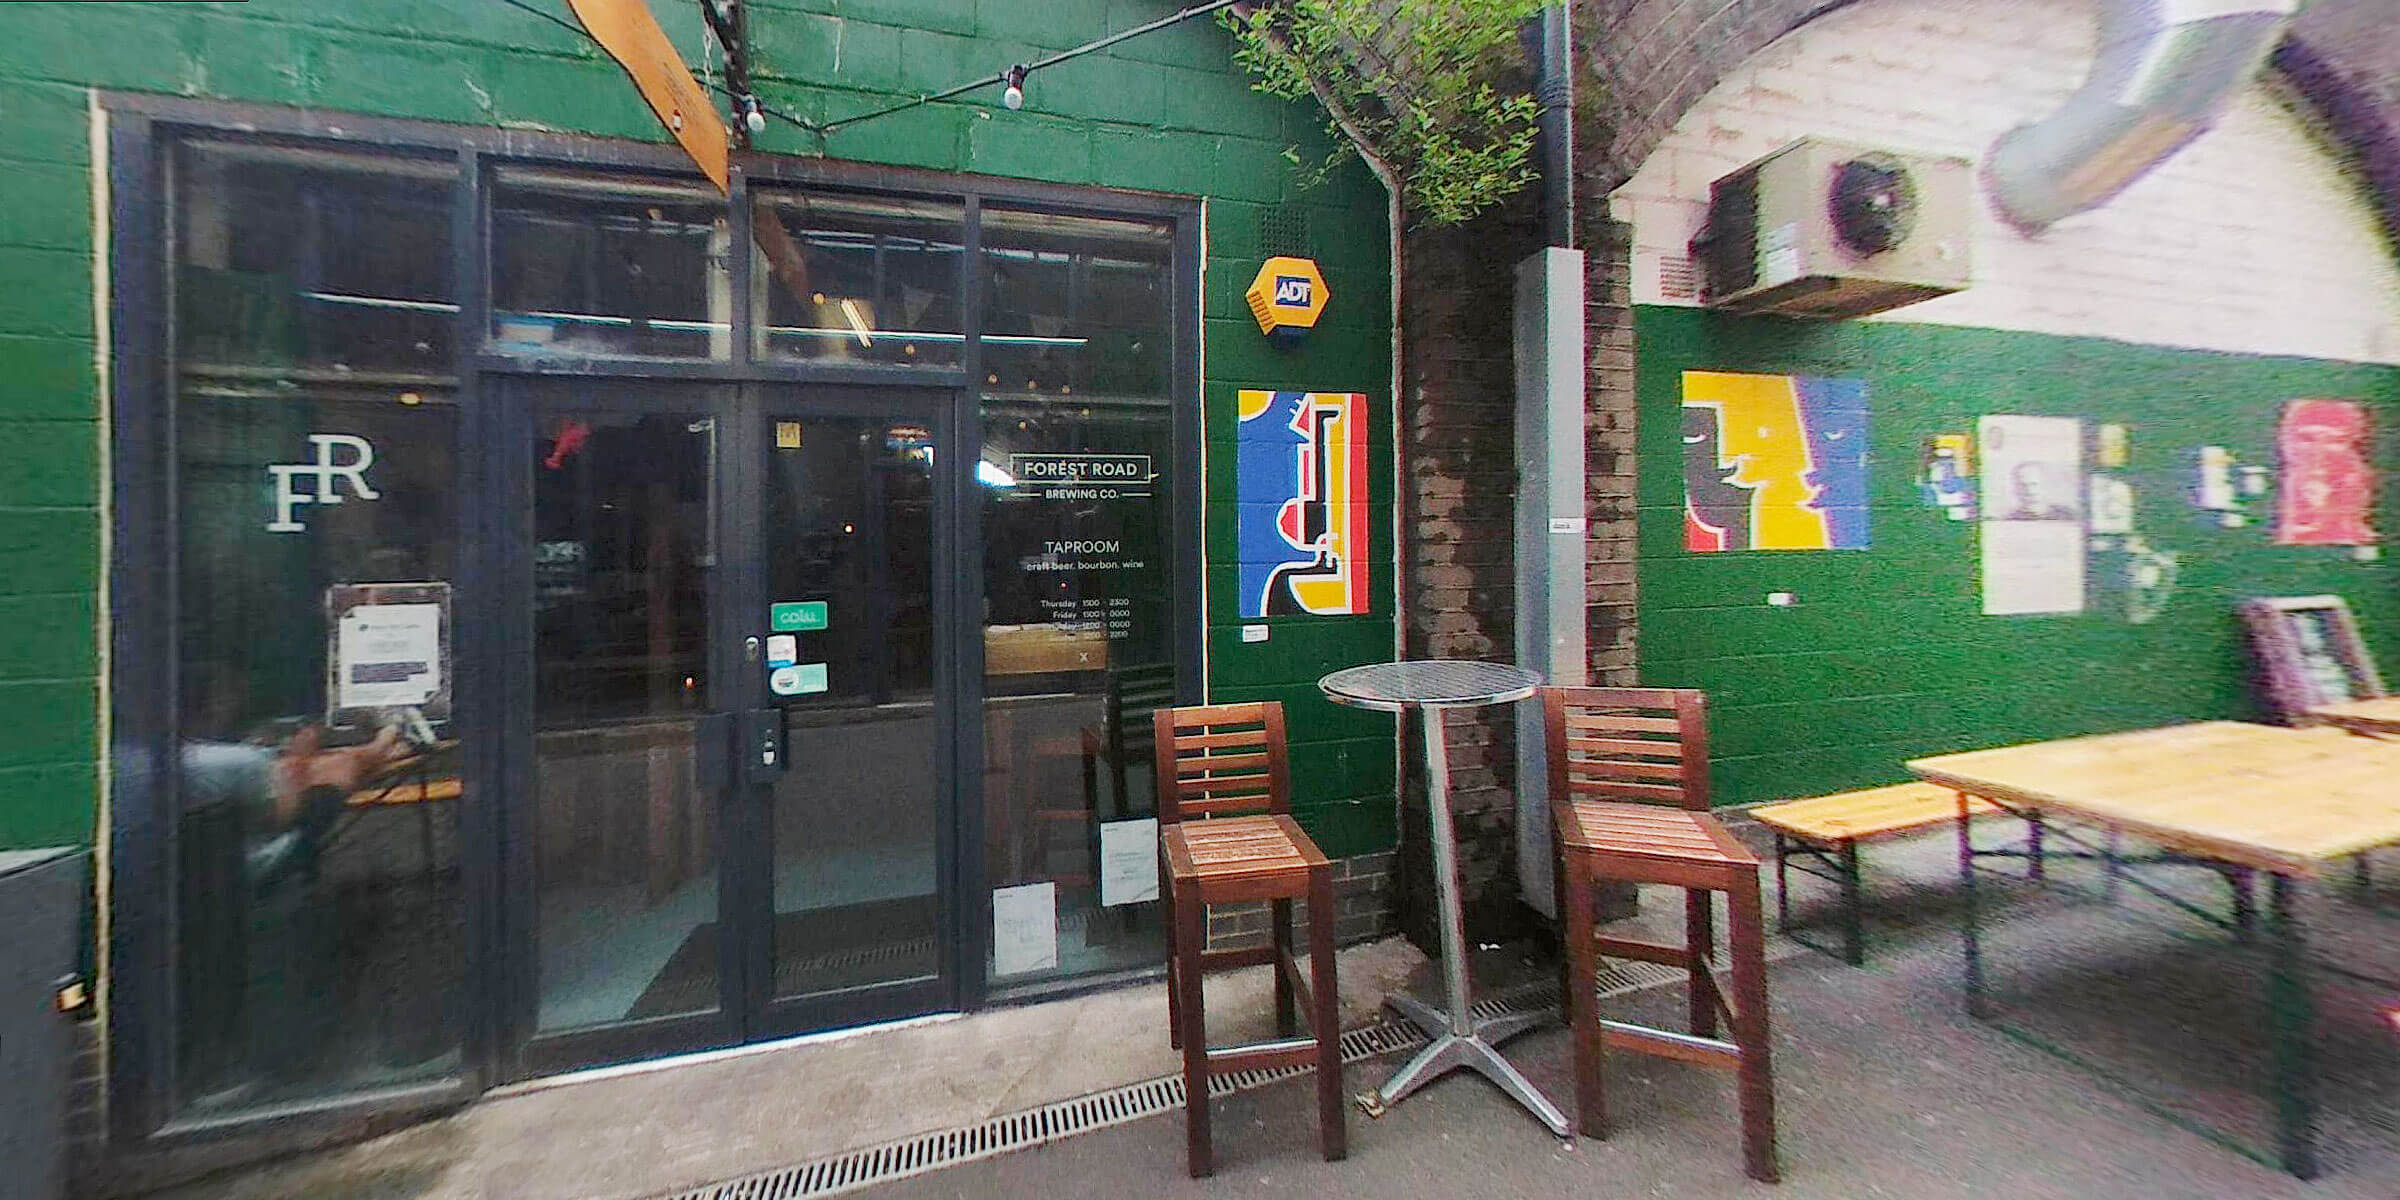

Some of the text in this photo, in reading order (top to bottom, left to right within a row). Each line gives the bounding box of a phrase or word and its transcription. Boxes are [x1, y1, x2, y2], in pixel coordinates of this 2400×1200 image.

[1276, 281, 1311, 302] ADT
[1024, 462, 1138, 476] FOREST ROAD
[1045, 489, 1097, 499] BREWING
[1045, 541, 1119, 553] TAPROOM
[1122, 559, 1145, 569] wine
[1040, 600, 1076, 608] Thursday
[1053, 611, 1077, 620] Friday
